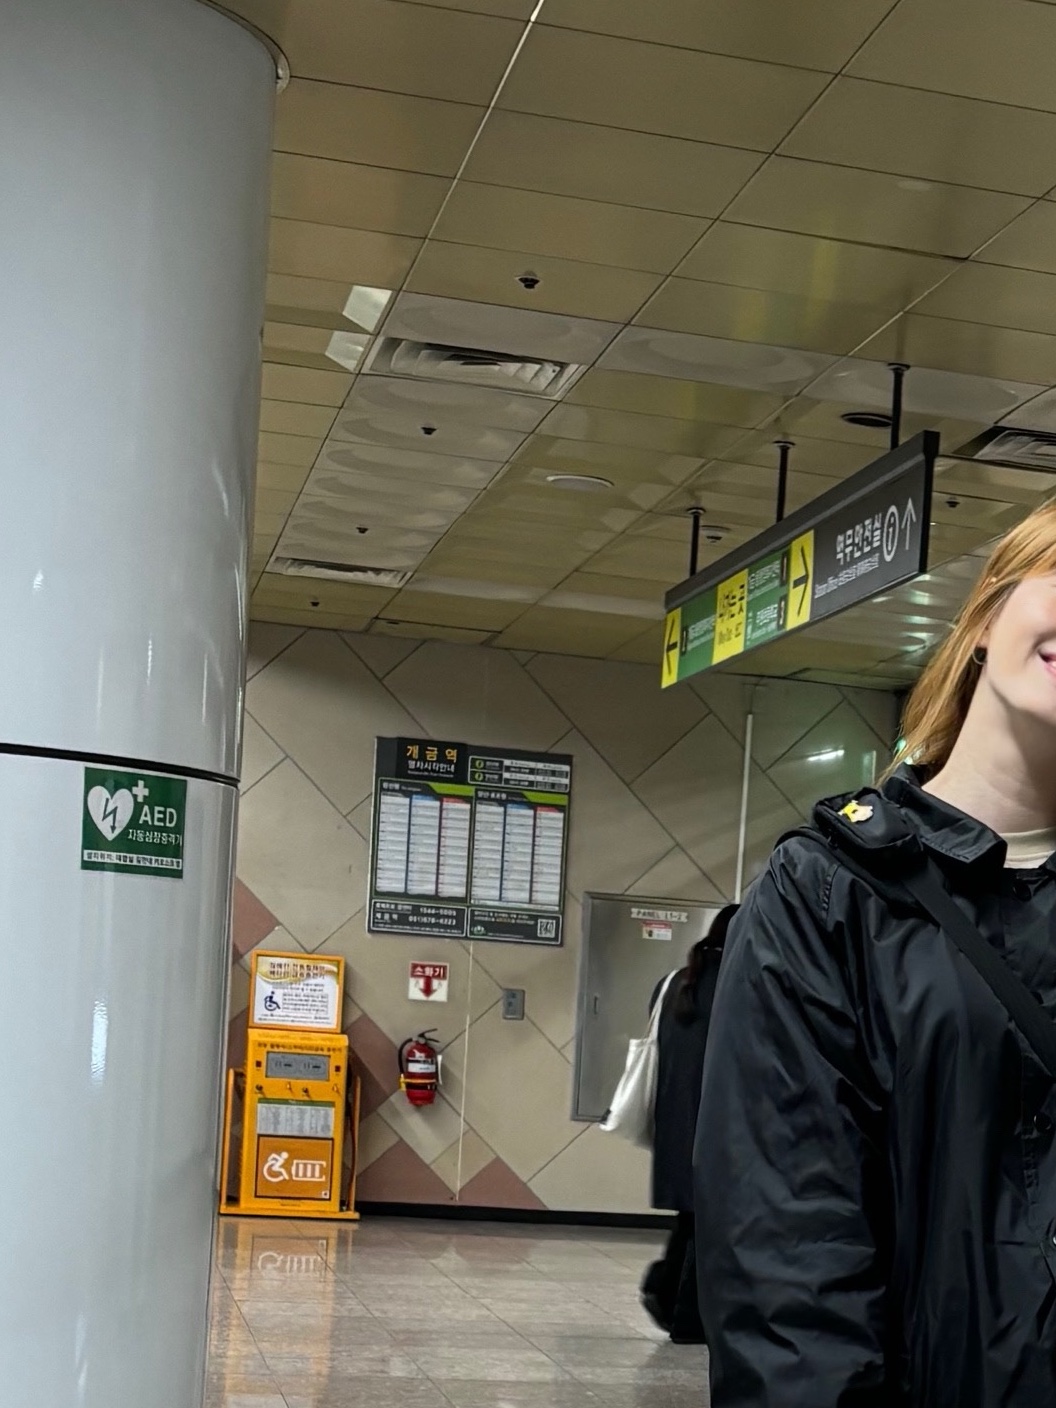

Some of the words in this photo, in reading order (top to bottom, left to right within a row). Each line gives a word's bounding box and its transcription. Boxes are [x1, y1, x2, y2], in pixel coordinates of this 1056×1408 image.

[836, 513, 882, 565] 역무안전실
[406, 745, 458, 763] 개금역
[139, 804, 177, 828] AED
[413, 966, 443, 978] 소화기
